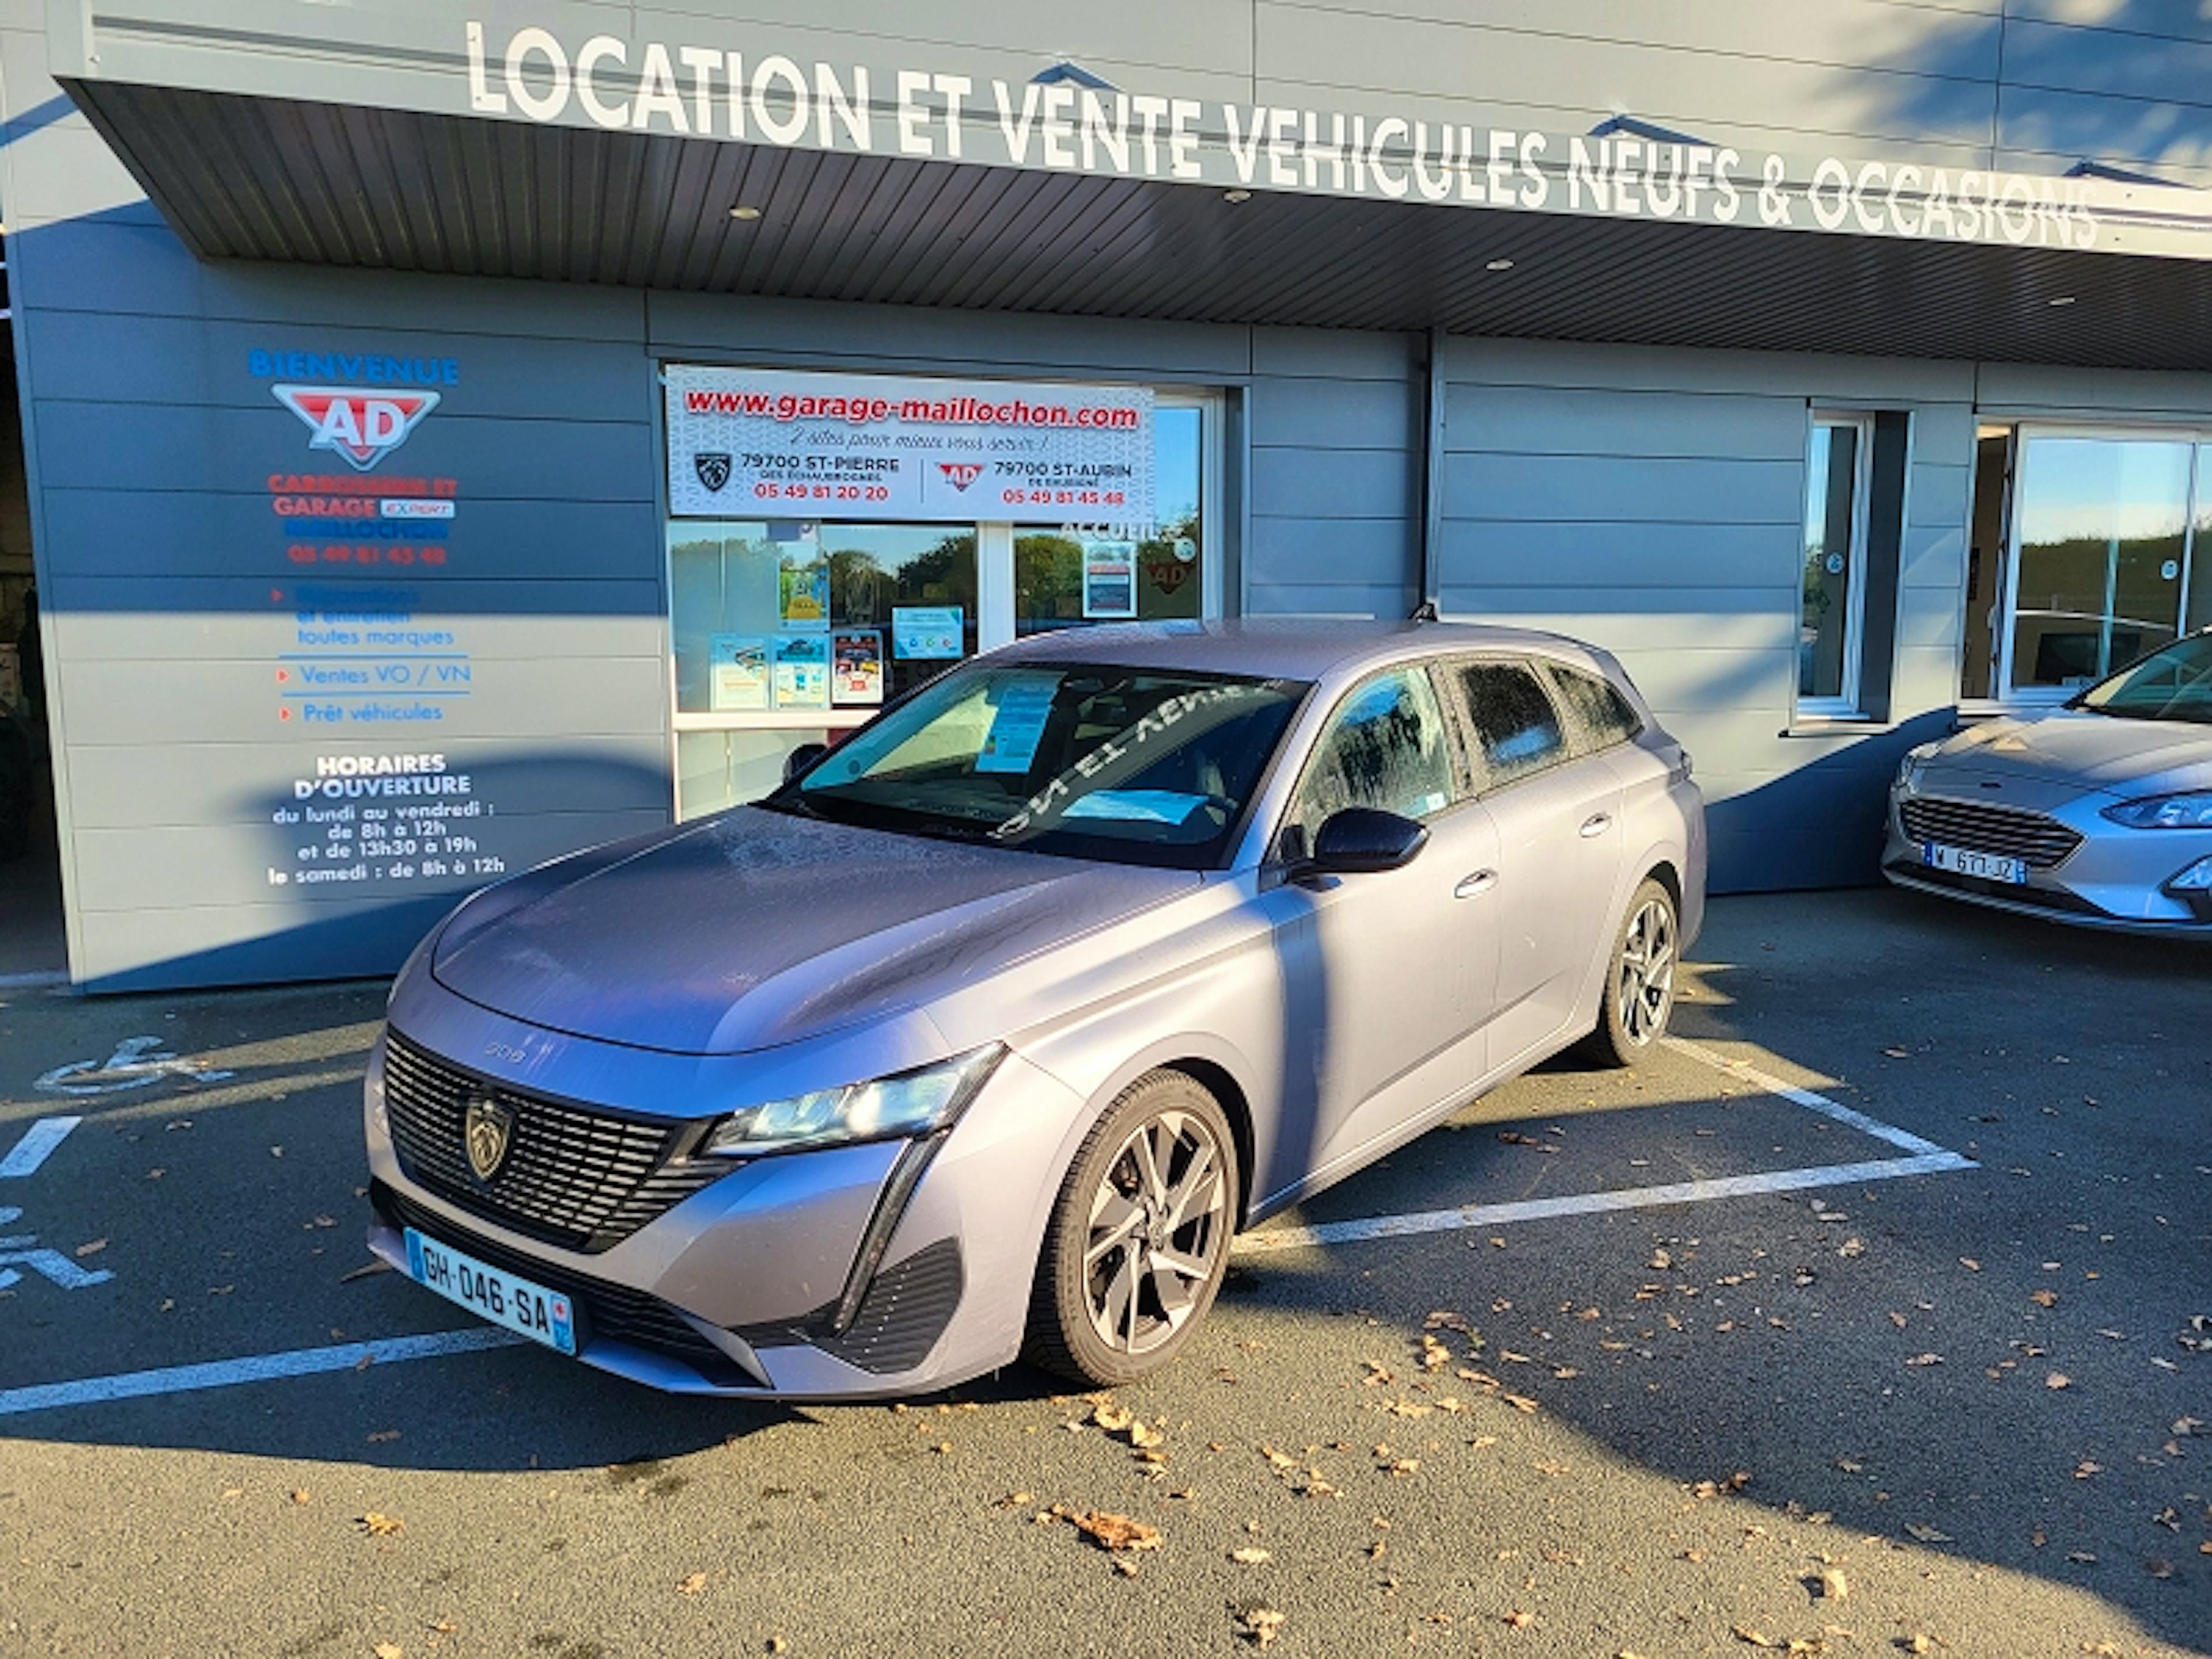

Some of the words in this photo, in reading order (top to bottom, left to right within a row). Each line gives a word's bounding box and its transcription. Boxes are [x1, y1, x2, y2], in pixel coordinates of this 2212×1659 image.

[464, 21, 870, 152] LOCATION
[896, 70, 972, 158] ET
[991, 79, 1204, 180] VENTE
[1222, 103, 1548, 209] VEHICULES
[1569, 135, 1740, 222] NEUFS
[1758, 154, 1793, 225] &
[1806, 157, 2098, 248] OCCASIONS
[249, 349, 459, 385] BIENVENUE
[686, 391, 1139, 429] www.garage-maillochon.com
[310, 397, 408, 447] AD
[742, 453, 800, 468] 79700
[806, 455, 900, 472] ST-PIERRE
[994, 461, 1048, 476] 79700
[754, 483, 778, 499] 05
[785, 484, 807, 499] 49
[813, 484, 831, 499] 81
[836, 486, 861, 500] 20
[865, 486, 888, 501] 20
[1003, 489, 1024, 505] 05
[1031, 490, 1051, 505] 49
[1056, 491, 1073, 505] 81
[1078, 491, 1099, 505] 45
[272, 497, 376, 517] GARAGE
[1059, 522, 1160, 541] ACCUEIL
[298, 629, 360, 645] toutes
[367, 630, 454, 647] marques
[300, 665, 369, 684] Ventes
[376, 665, 410, 684] VO
[436, 665, 471, 683] VN
[303, 703, 343, 721] Prêt
[349, 701, 443, 721] véhicules
[316, 754, 446, 776] HORAIRES
[294, 776, 472, 800] D'OUVERTURE
[272, 807, 300, 824] du
[306, 805, 355, 823] lundi
[363, 808, 389, 820] au
[395, 801, 480, 819] vendredi
[327, 824, 353, 840] de
[361, 823, 386, 838] 8h
[414, 820, 447, 836] 12h
[297, 843, 319, 860] et
[325, 843, 351, 859] de
[358, 838, 417, 857] 13h30
[444, 837, 478, 853] 19h
[268, 868, 288, 885] le
[295, 864, 368, 883] samedi
[389, 863, 415, 878] de
[422, 860, 448, 876] 8h
[474, 857, 506, 873] 12h
